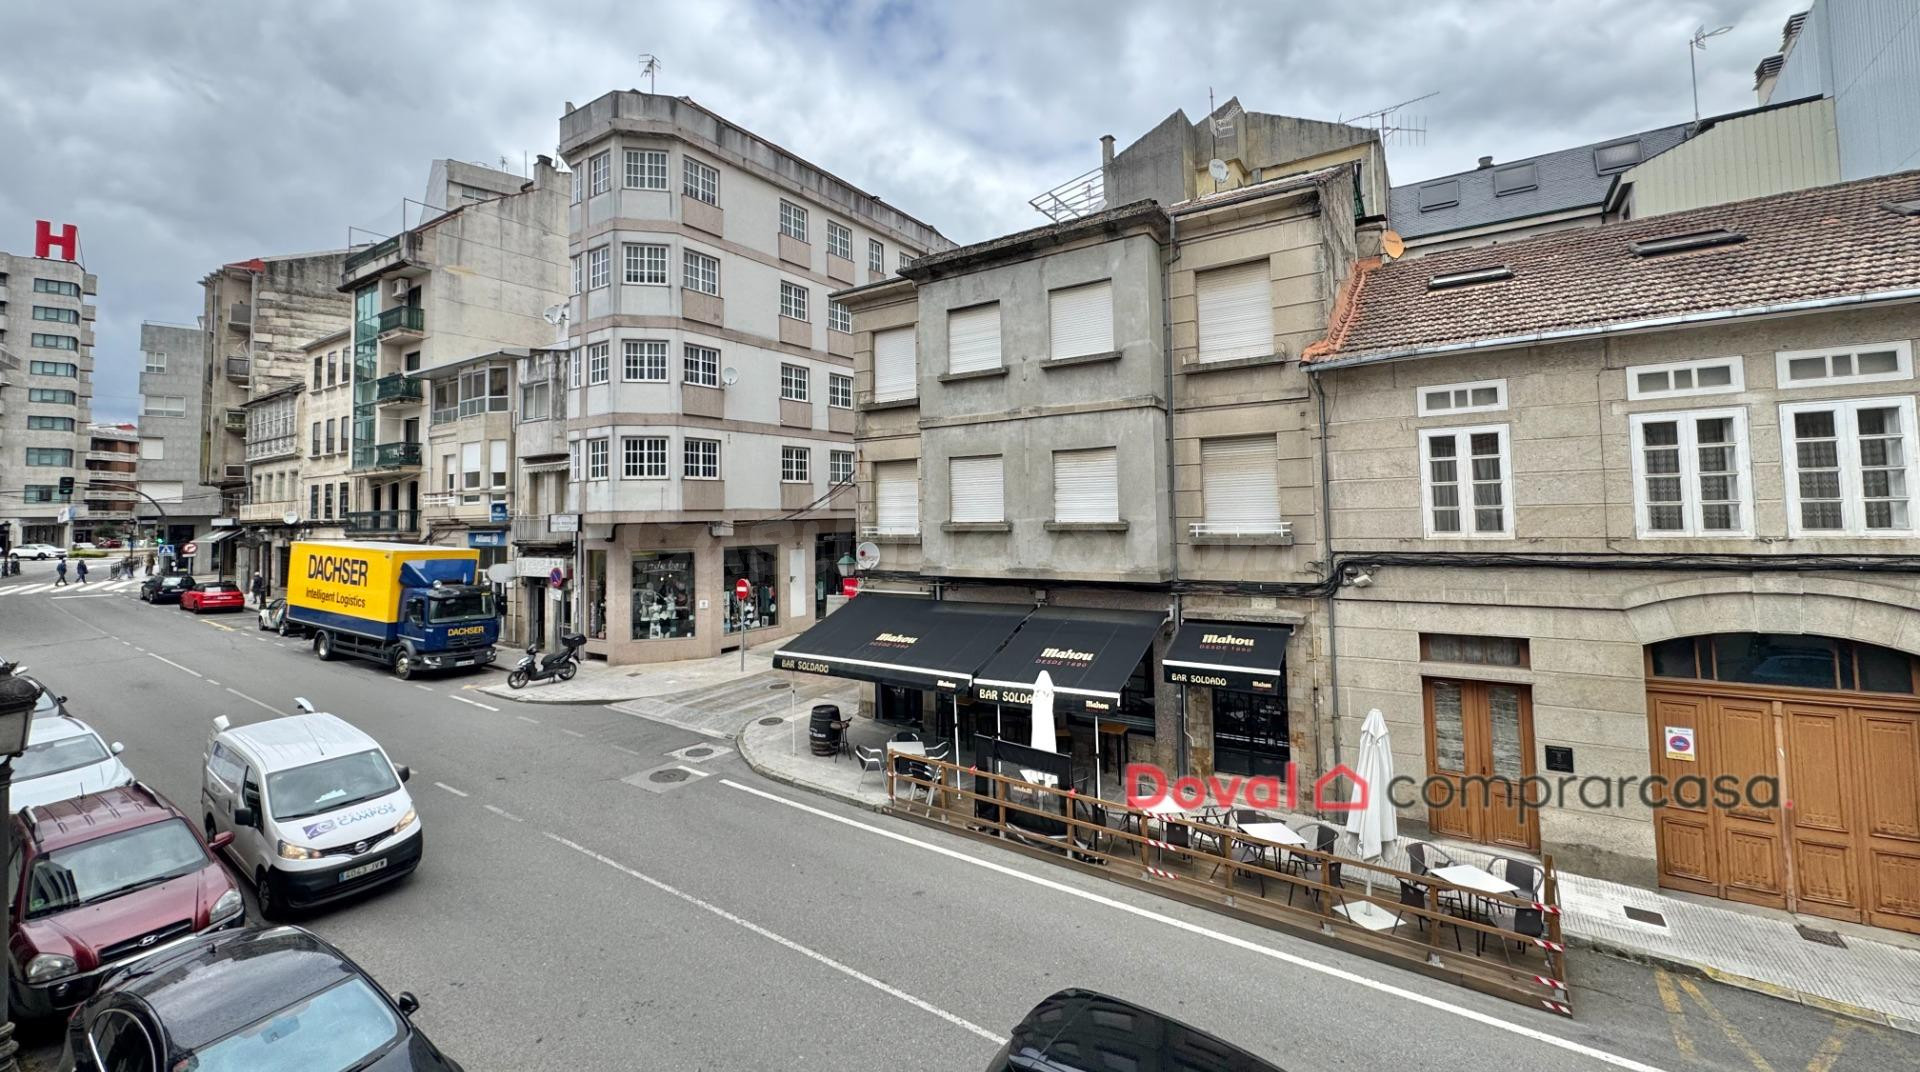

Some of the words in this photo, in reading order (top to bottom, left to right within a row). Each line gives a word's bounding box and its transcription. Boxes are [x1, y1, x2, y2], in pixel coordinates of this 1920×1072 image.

[35, 219, 77, 261] H
[307, 554, 369, 587] DACHSER
[305, 587, 335, 604] Intelligent
[336, 592, 366, 608] Logistics
[447, 625, 484, 637] DACHSER
[1202, 634, 1255, 646] Mahou
[1040, 647, 1094, 661] Mahou
[781, 658, 795, 669] BAR
[797, 660, 829, 673] SOLDADO
[1171, 673, 1188, 682] BAR
[1190, 674, 1227, 686] SOLDADO
[979, 688, 998, 701] BAR
[1002, 691, 1034, 705] SOLDA
